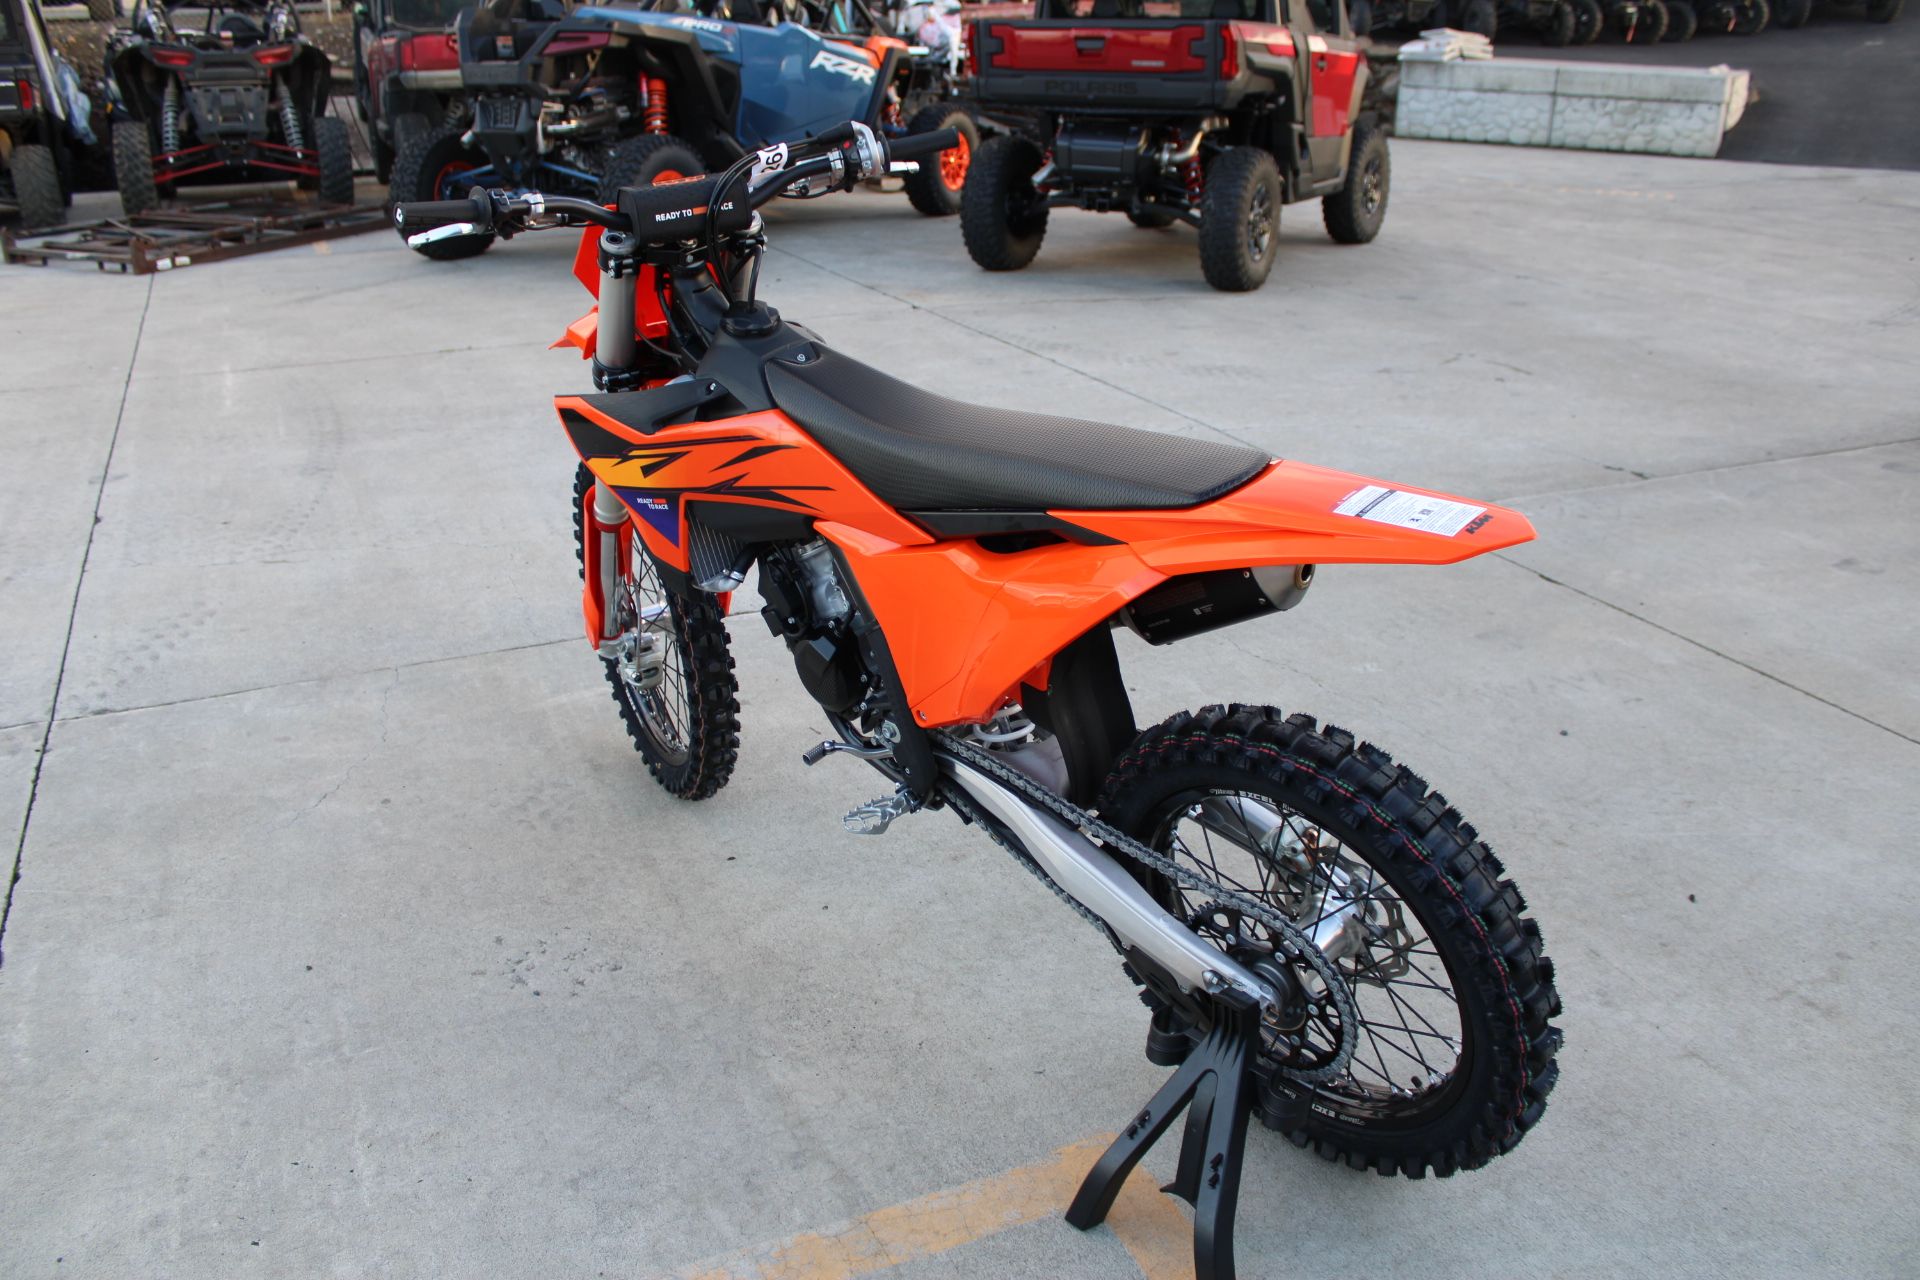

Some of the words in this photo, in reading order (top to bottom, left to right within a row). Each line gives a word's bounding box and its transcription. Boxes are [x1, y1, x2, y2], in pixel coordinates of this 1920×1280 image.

[810, 50, 876, 85] RZR
[1044, 79, 1137, 95] POLARIS
[655, 210, 681, 222] READY
[682, 208, 693, 217] TO
[1239, 790, 1277, 805] EXCEL
